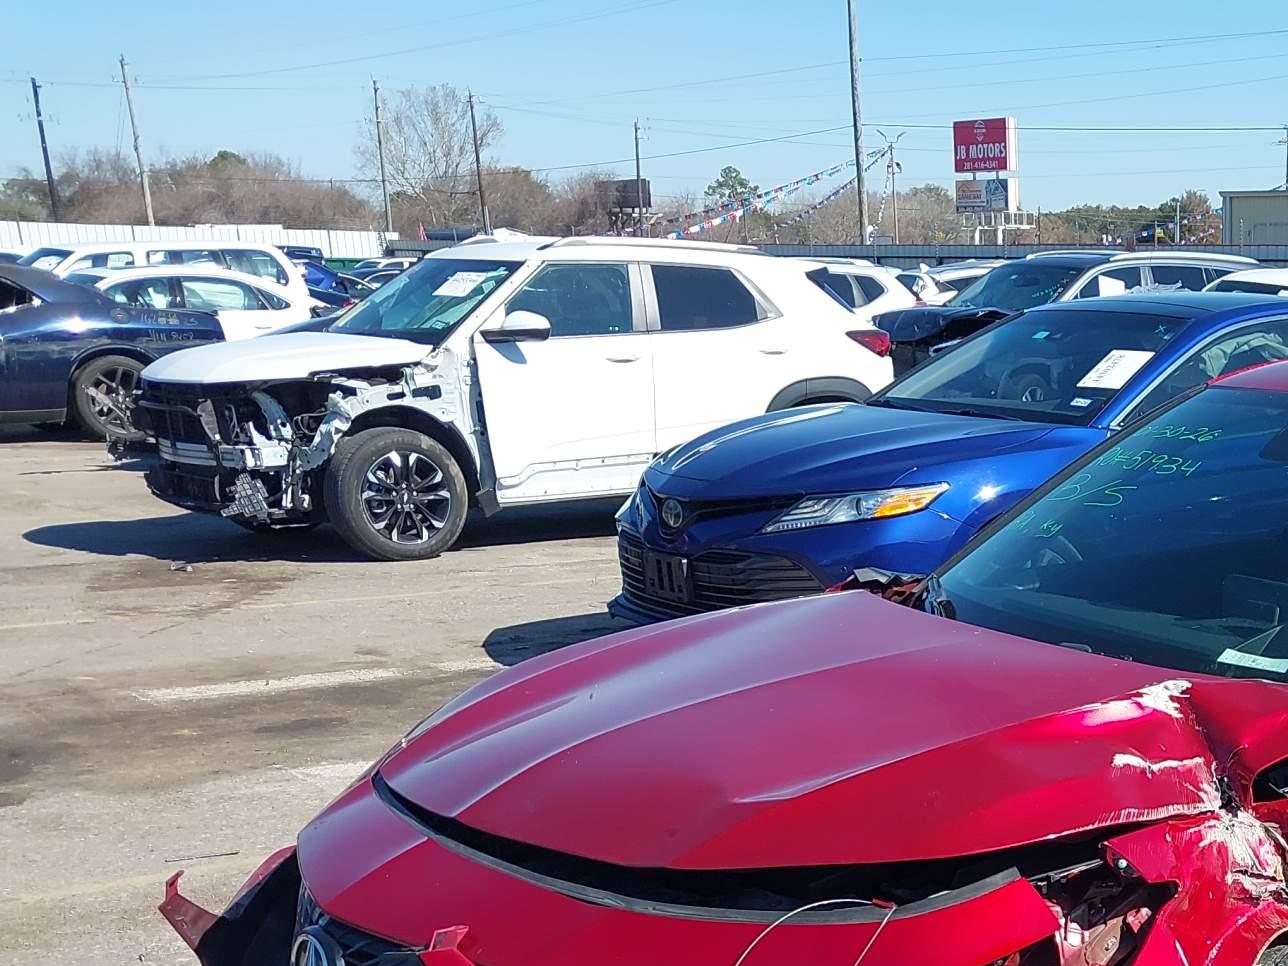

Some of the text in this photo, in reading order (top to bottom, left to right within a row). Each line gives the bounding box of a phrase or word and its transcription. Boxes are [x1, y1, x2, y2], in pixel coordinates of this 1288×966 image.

[956, 142, 1006, 160] JB MOTORS
[1047, 473, 1138, 507] 3/5
